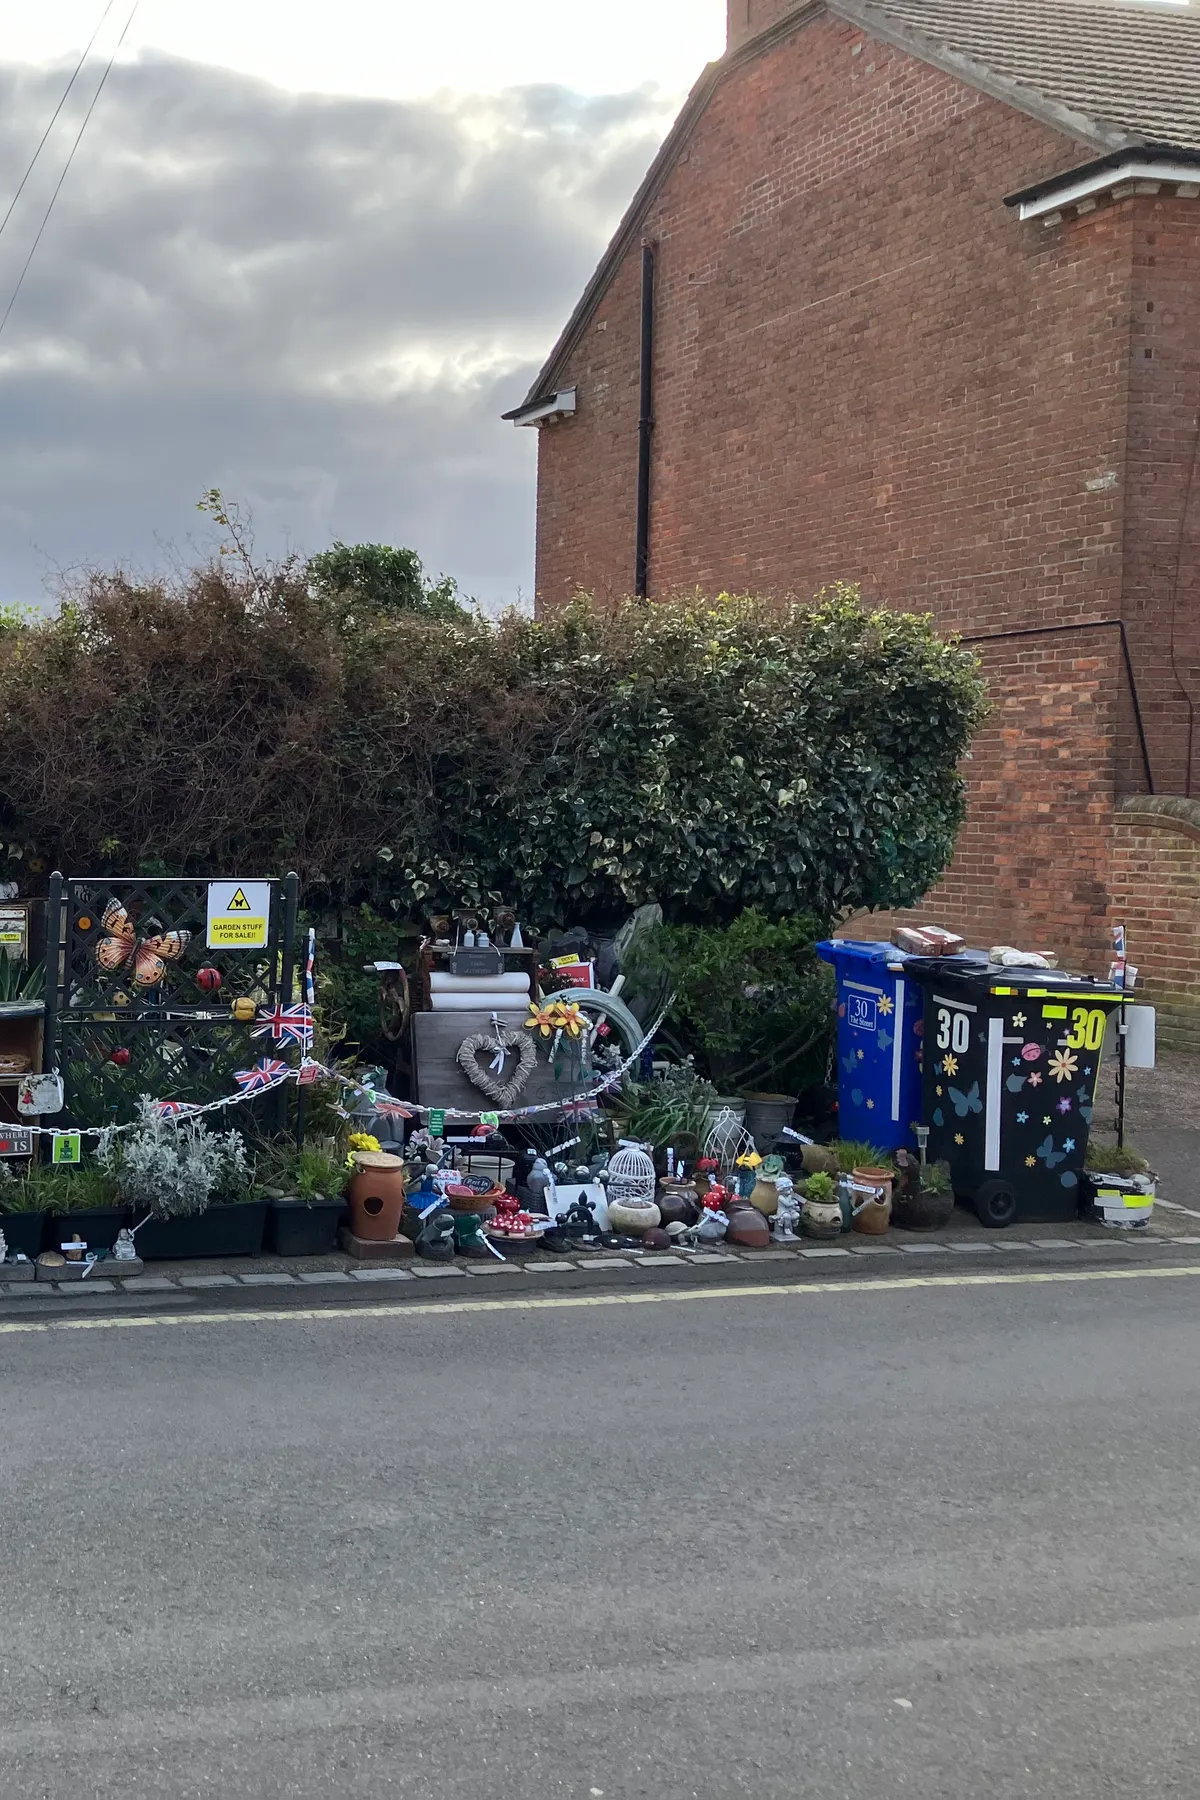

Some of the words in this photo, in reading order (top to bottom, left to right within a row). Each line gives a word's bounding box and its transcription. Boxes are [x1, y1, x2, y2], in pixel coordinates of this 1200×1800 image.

[854, 999, 868, 1018] 30
[850, 1014, 859, 1025] The
[859, 1017, 874, 1029] Street
[937, 1008, 970, 1053] 30
[1067, 1007, 1106, 1050] 30
[13, 1140, 28, 1152] IS
